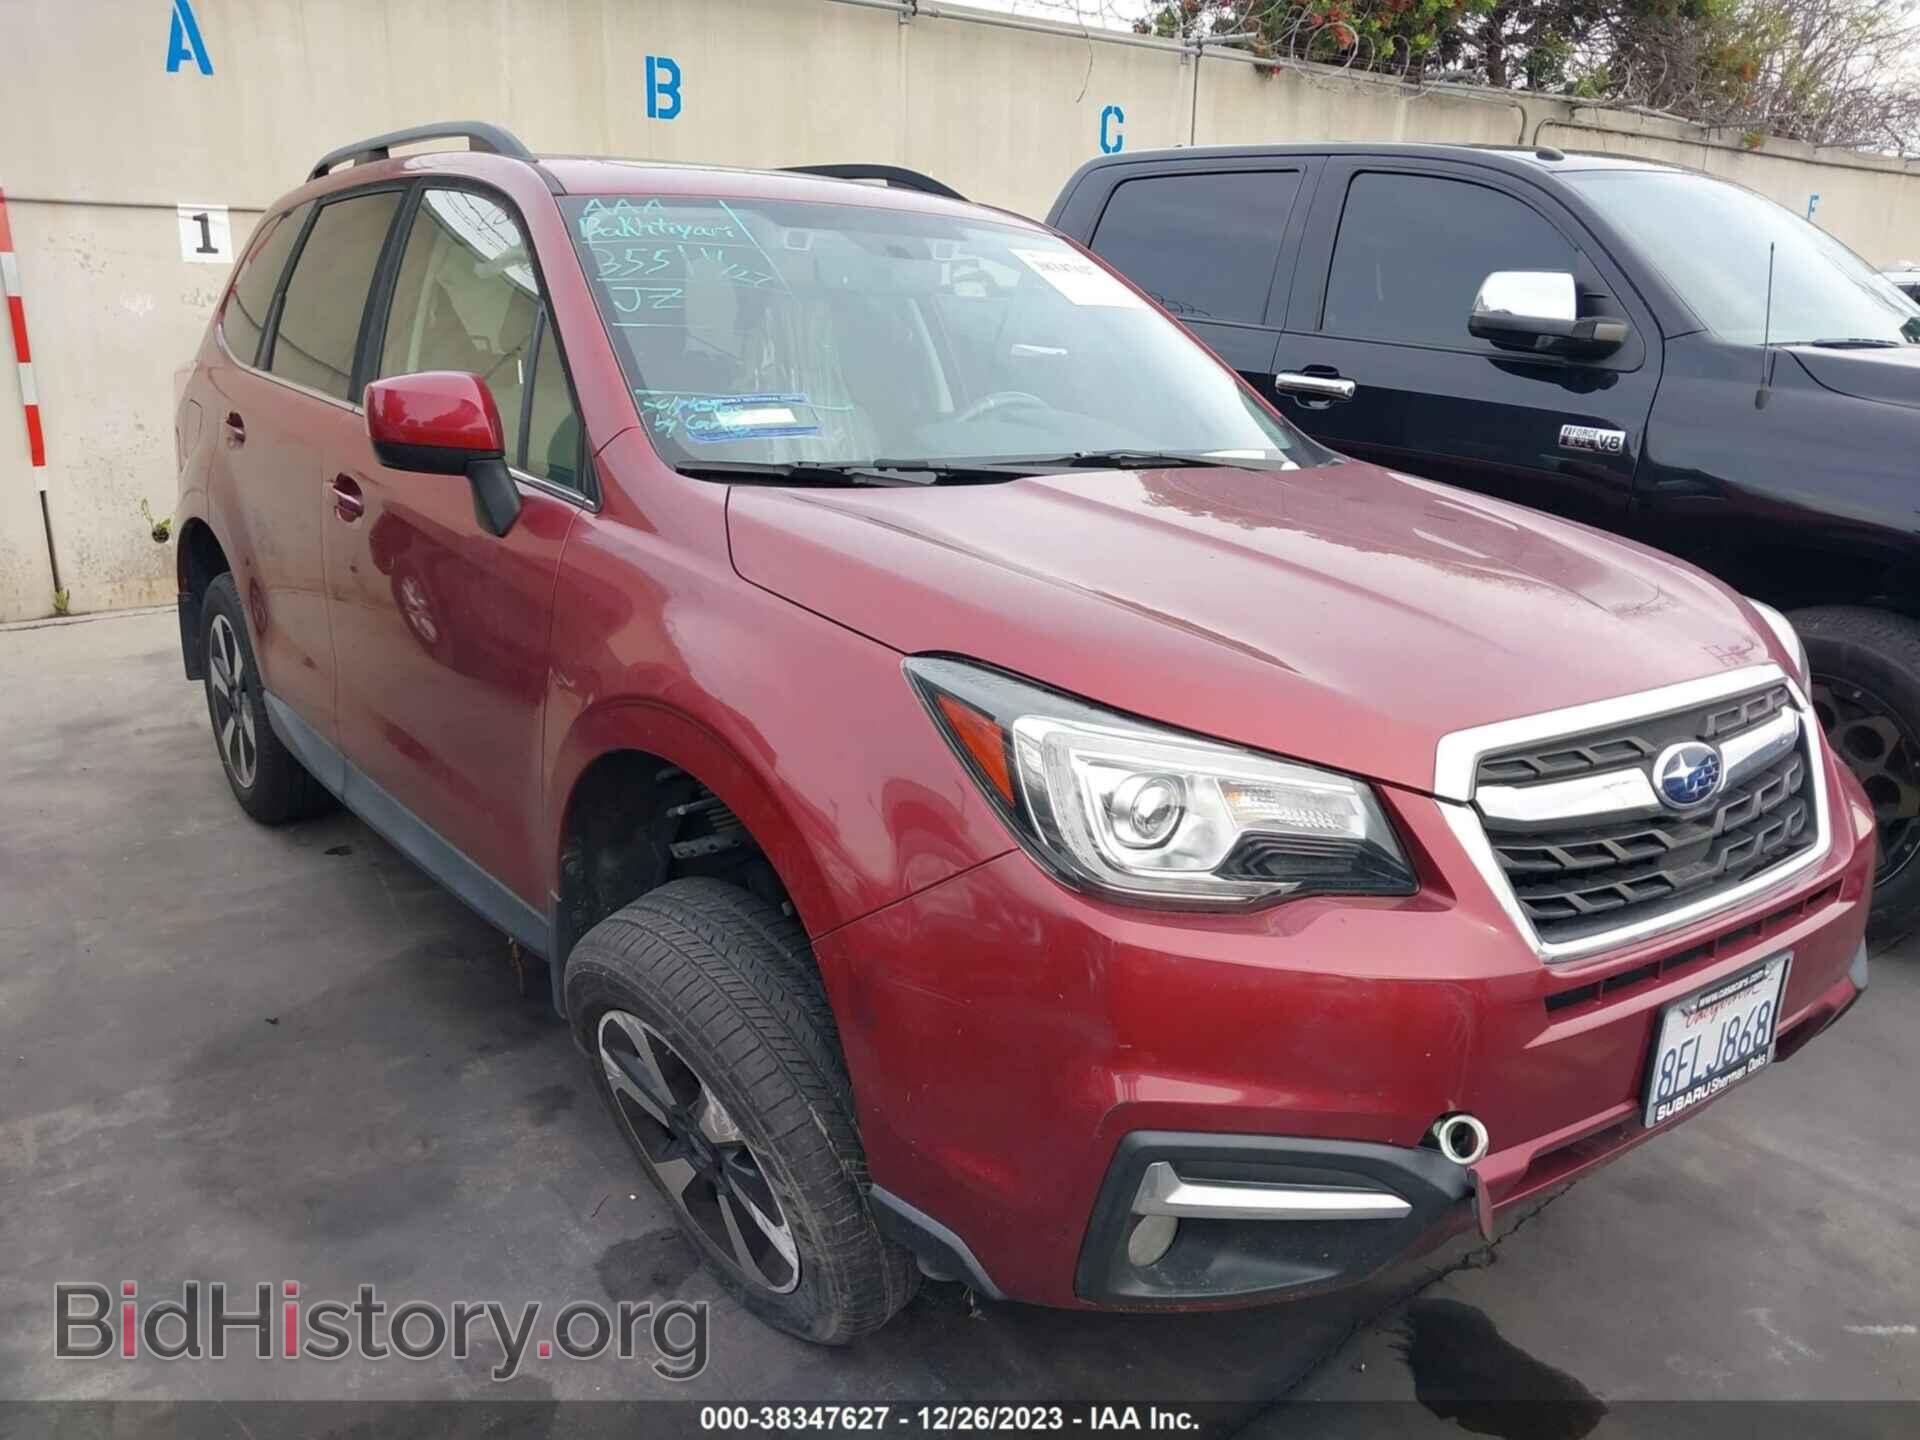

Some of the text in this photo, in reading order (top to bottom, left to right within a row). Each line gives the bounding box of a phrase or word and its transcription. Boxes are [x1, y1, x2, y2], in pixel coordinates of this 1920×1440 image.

[166, 0, 214, 75] A
[645, 55, 682, 119] B
[1100, 105, 1124, 154] C
[192, 212, 219, 255] 1
[1599, 433, 1622, 451] V8
[1656, 1000, 1772, 1100] 8FLJ868
[1656, 1082, 1712, 1121] SUBARU
